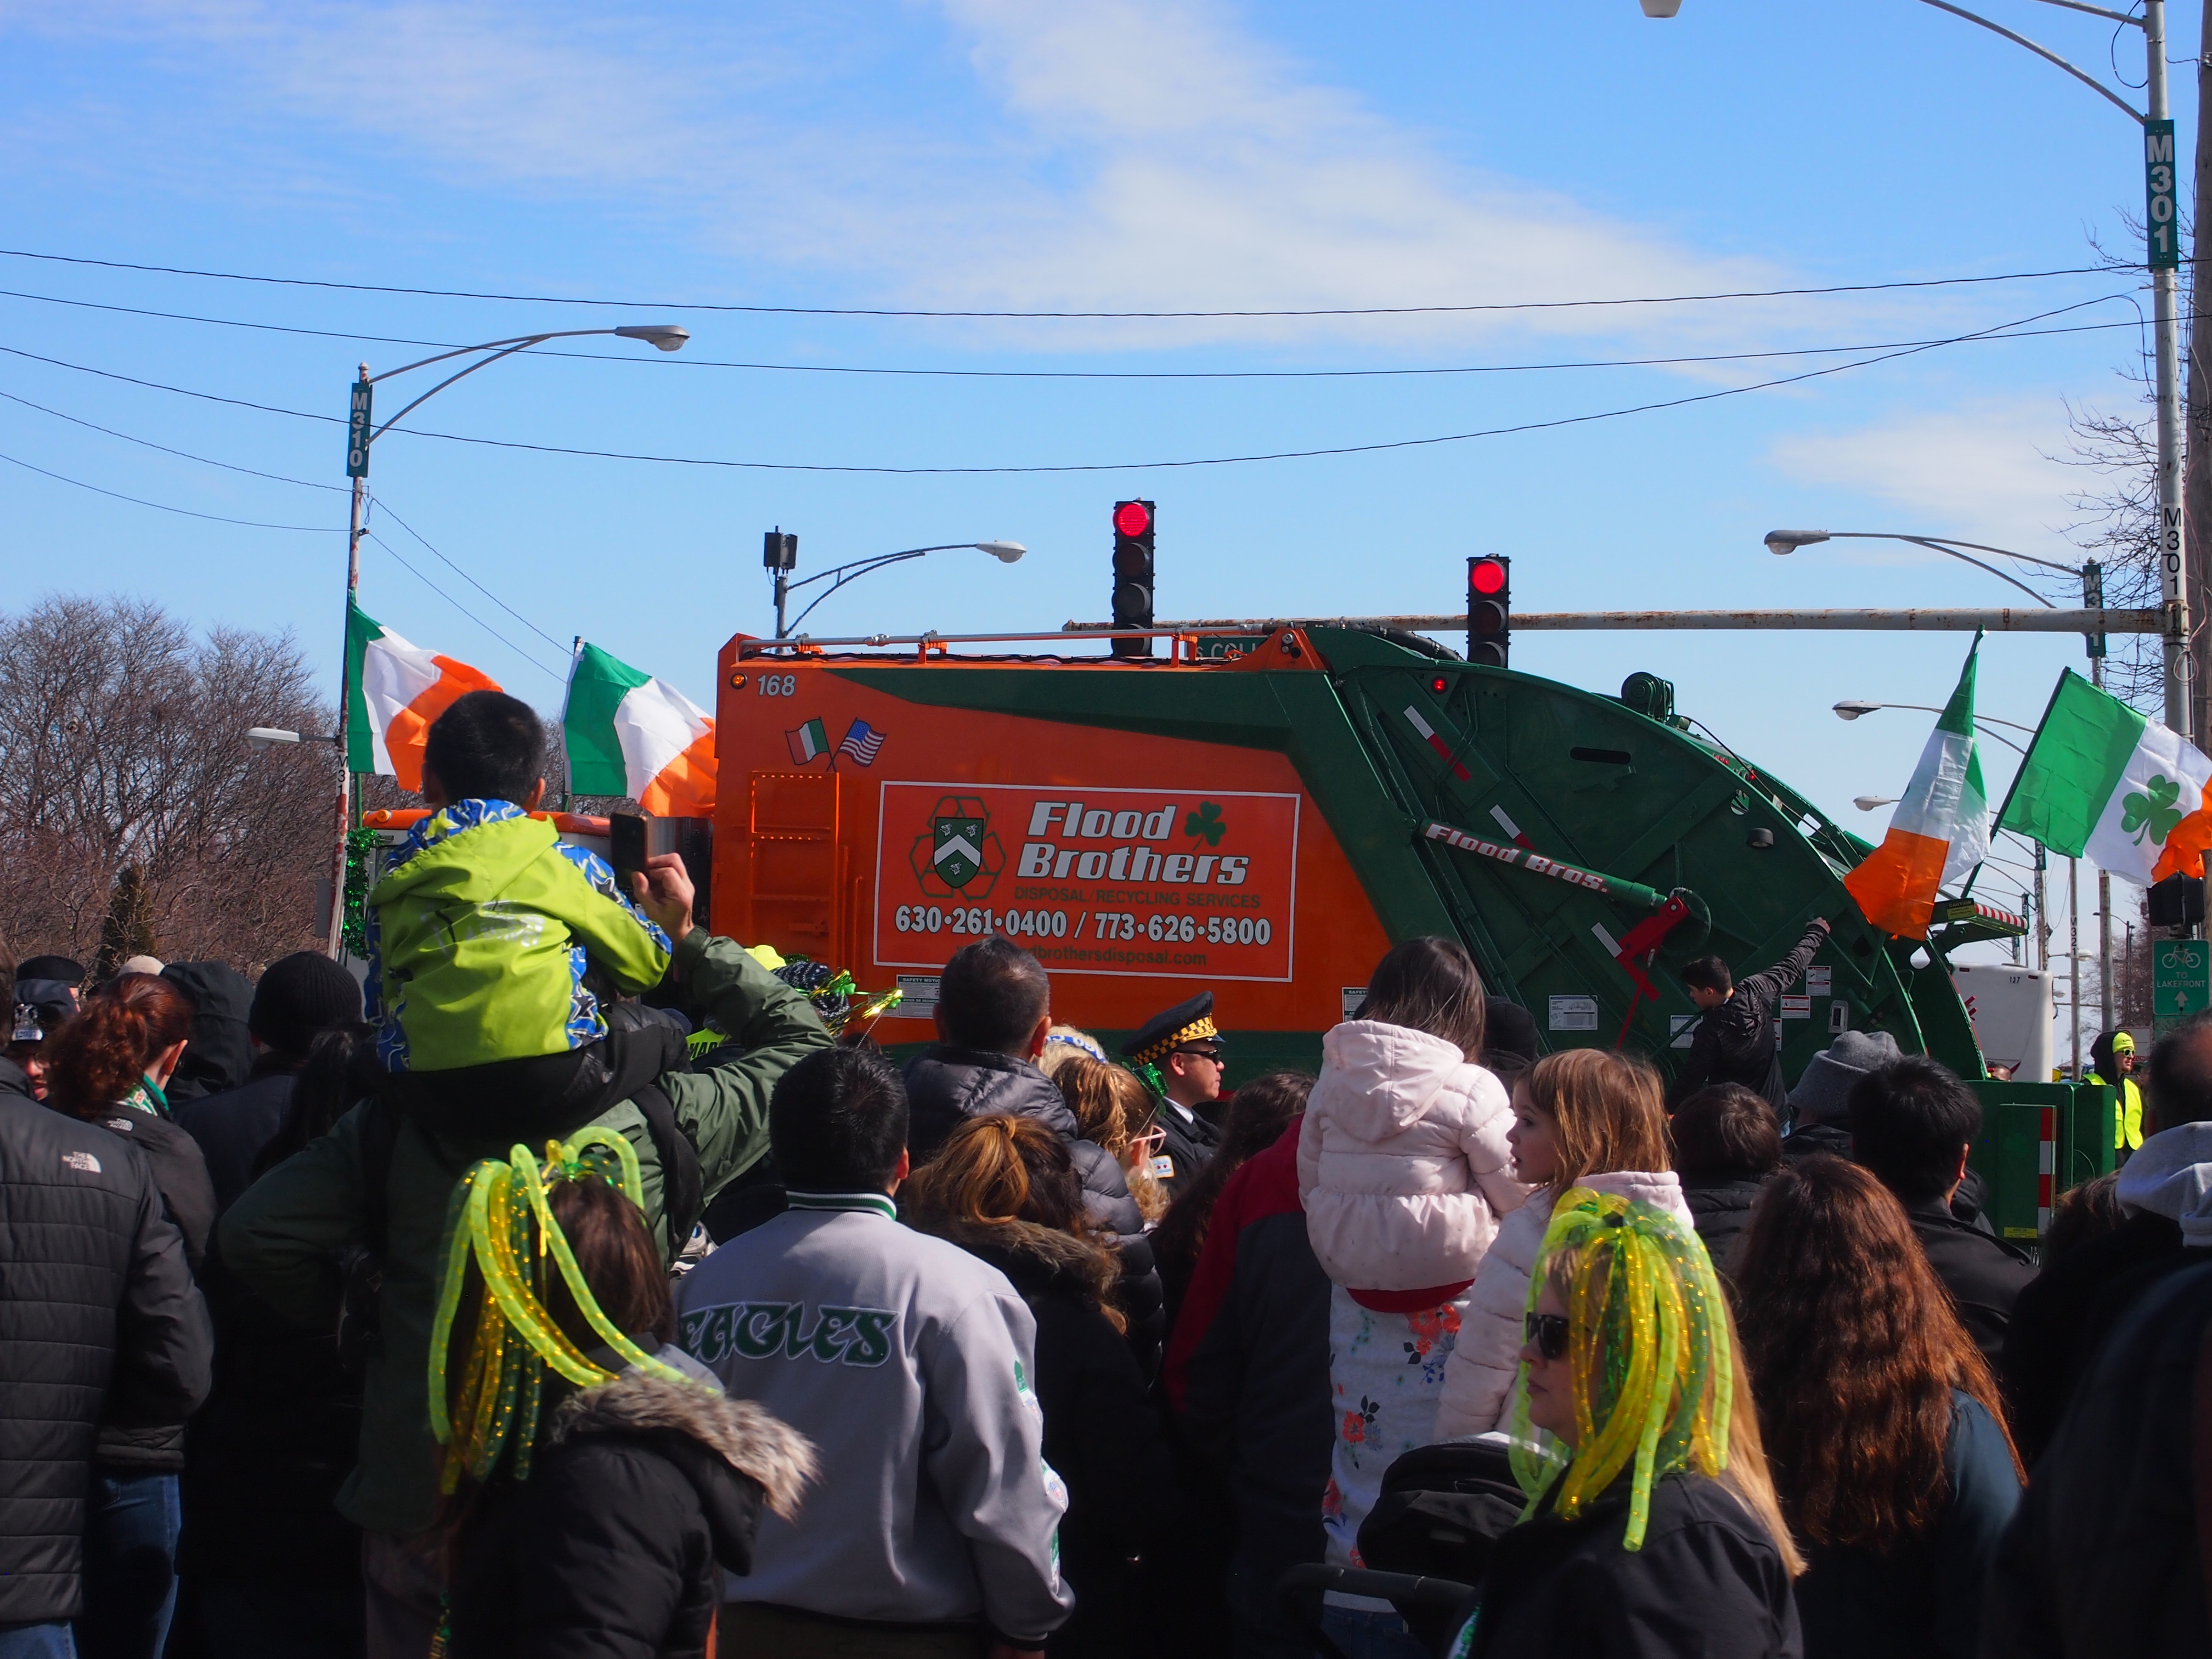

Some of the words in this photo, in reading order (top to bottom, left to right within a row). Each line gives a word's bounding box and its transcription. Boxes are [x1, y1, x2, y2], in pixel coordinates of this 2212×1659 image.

[2147, 135, 2172, 253] M301
[349, 392, 368, 467] M310
[2164, 507, 2181, 595] M301
[2085, 574, 2101, 647] M31
[757, 675, 795, 696] 168
[1028, 801, 1177, 840] Flood
[1017, 843, 1249, 884] Brothers
[1426, 823, 1520, 864] Flood
[1525, 854, 1608, 893] Bros.
[1187, 893, 1260, 908] SERVICES
